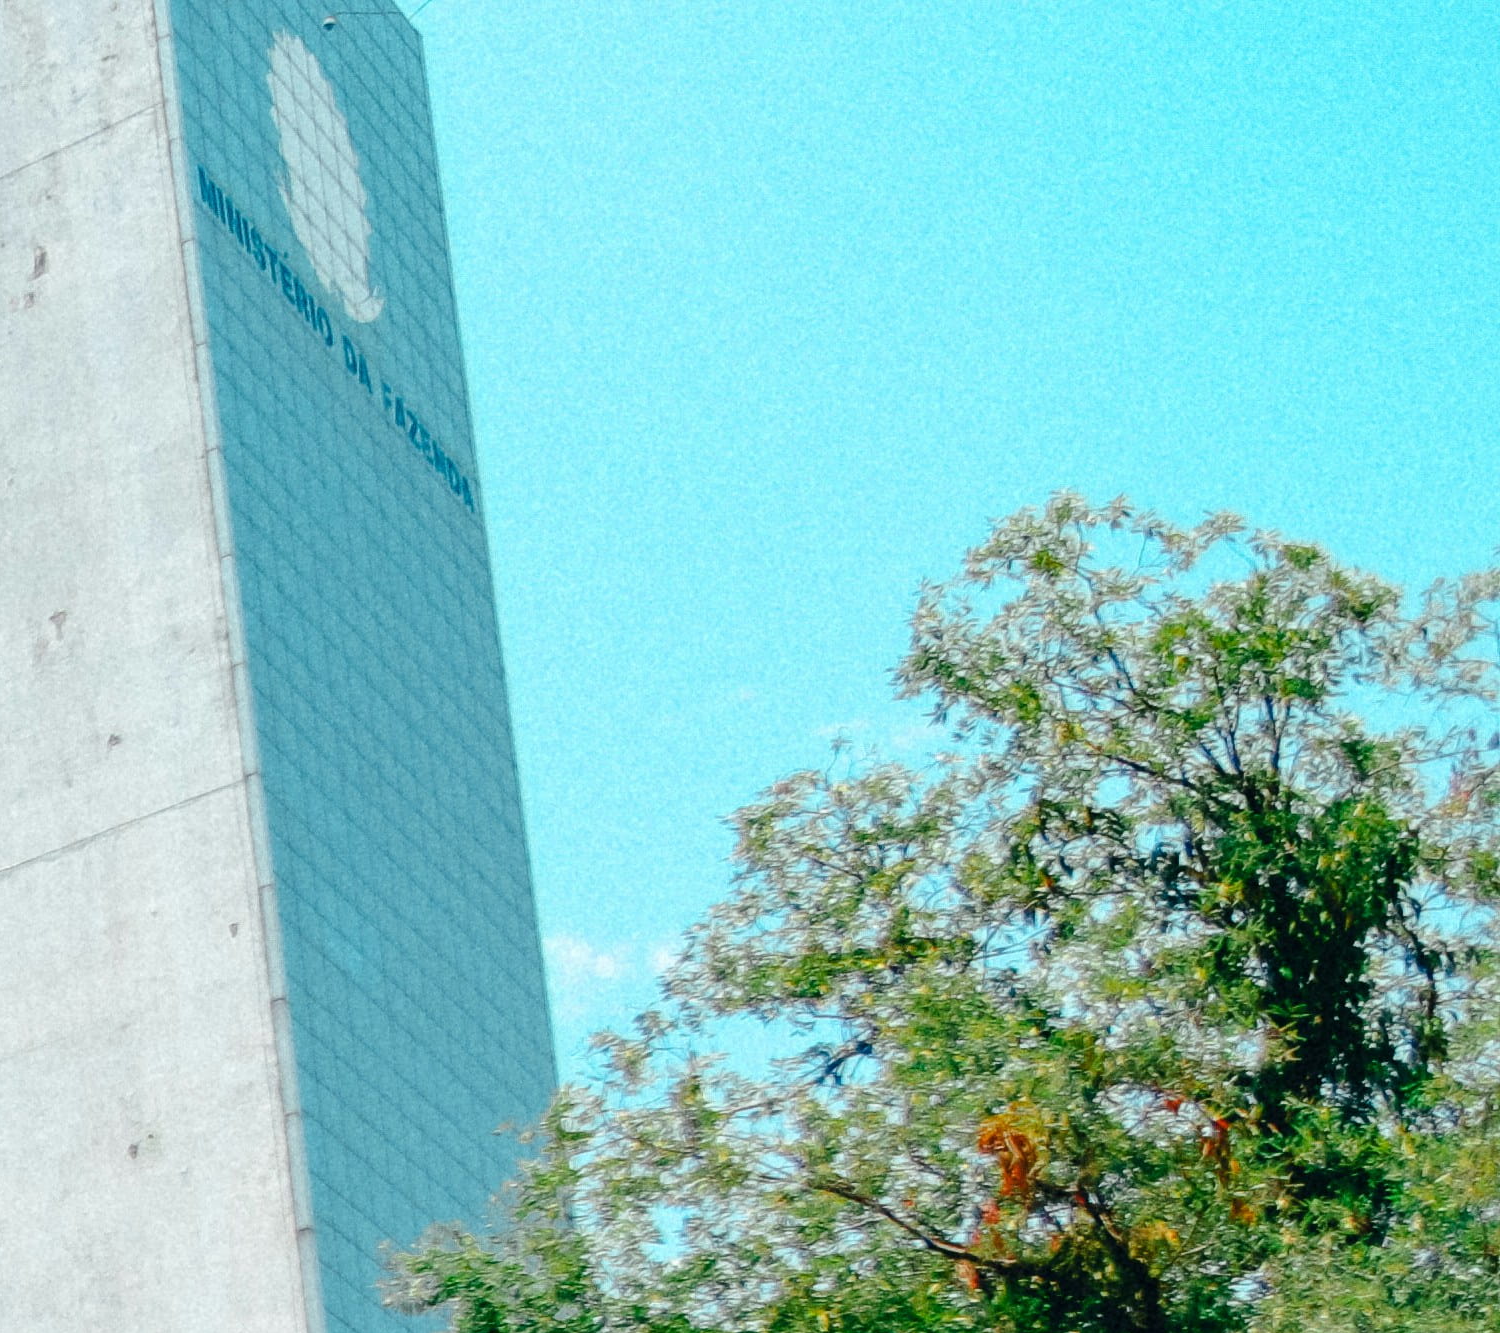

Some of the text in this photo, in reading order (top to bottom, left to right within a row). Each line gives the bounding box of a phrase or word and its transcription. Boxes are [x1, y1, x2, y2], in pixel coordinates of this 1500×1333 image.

[197, 164, 476, 514] MINISTÉRIO DA FAZENDA
